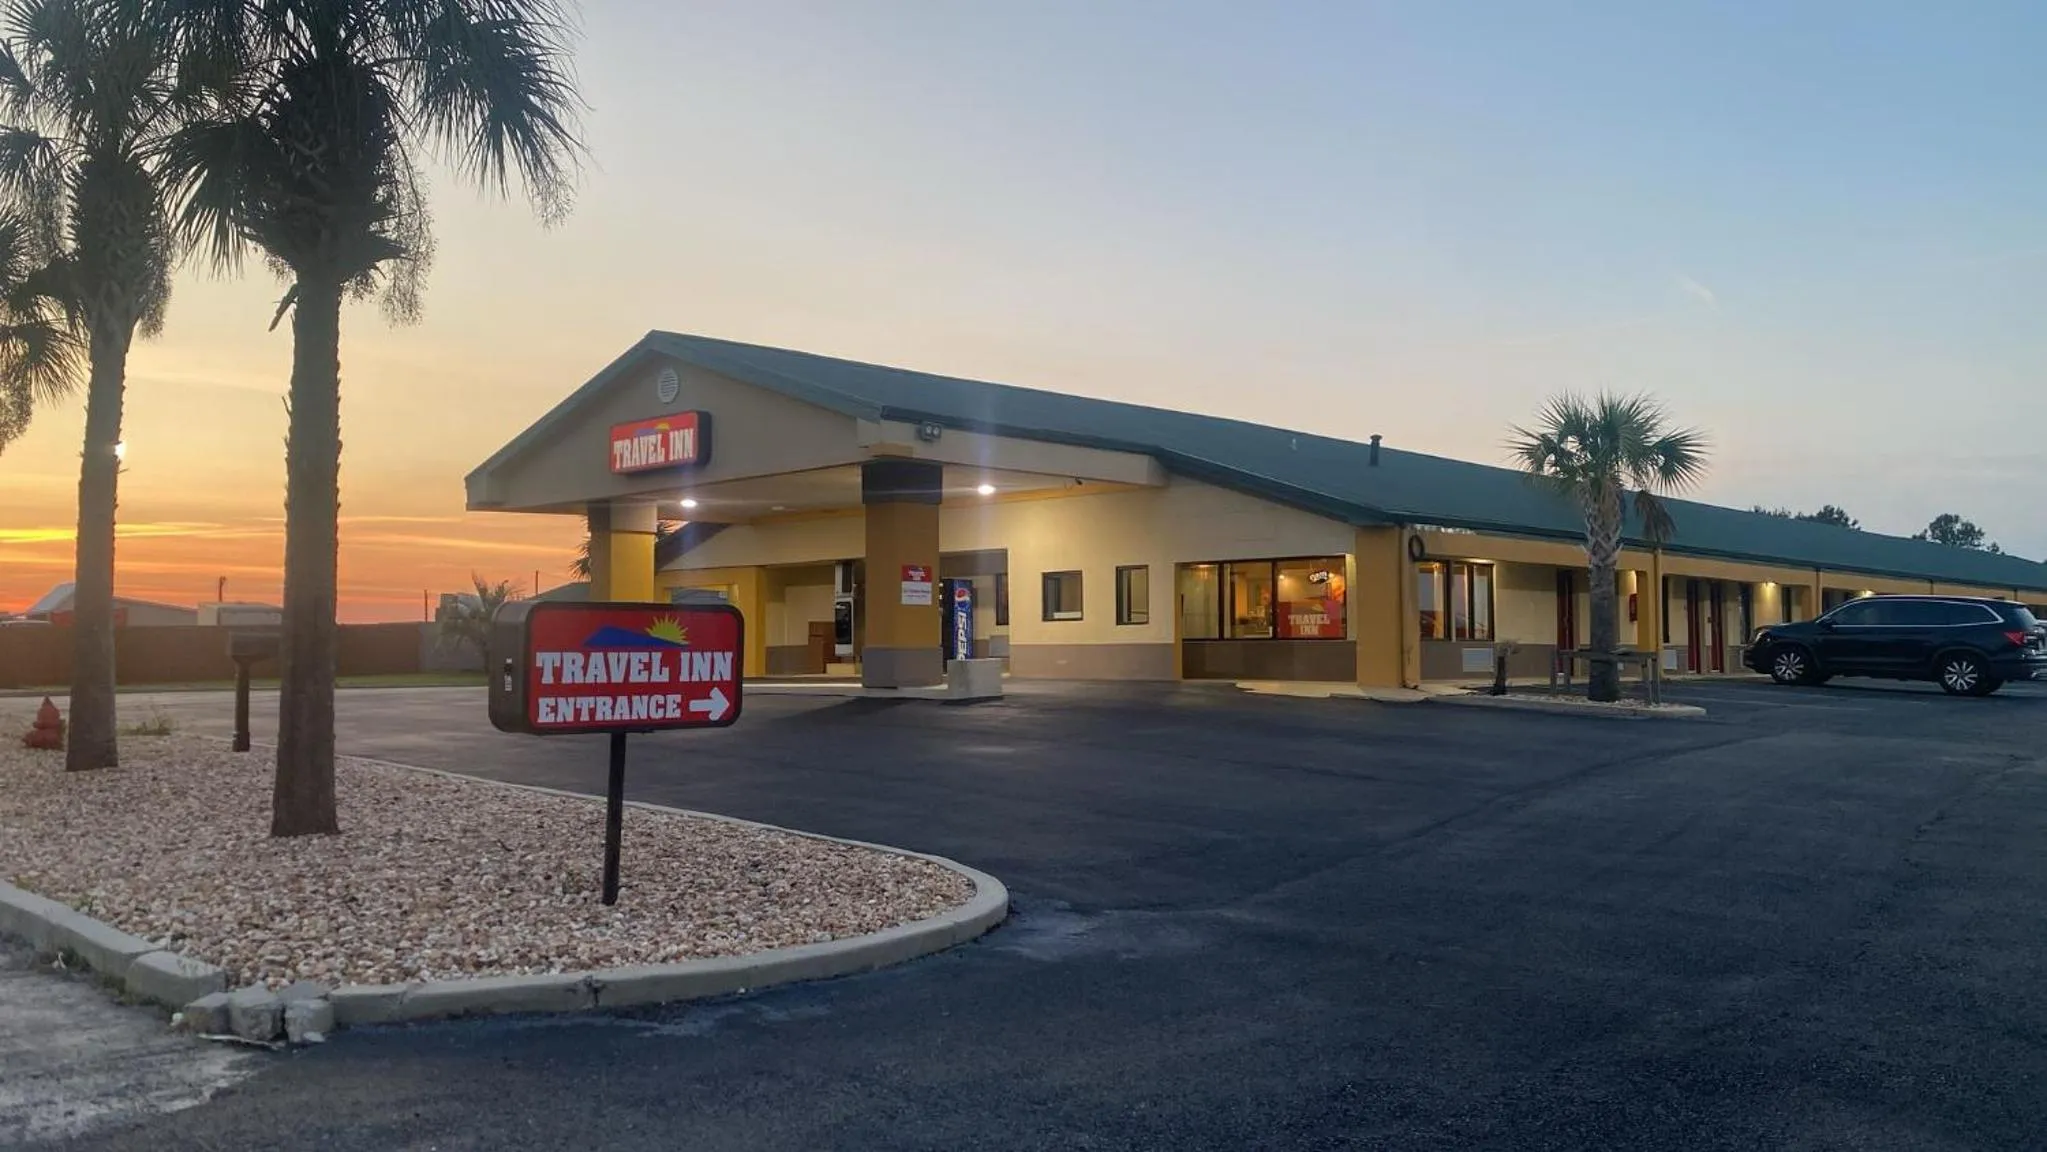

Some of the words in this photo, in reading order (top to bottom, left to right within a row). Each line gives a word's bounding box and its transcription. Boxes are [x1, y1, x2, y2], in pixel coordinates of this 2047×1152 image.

[613, 433, 665, 470] TRAVEL
[668, 428, 694, 461] INN
[1288, 613, 1330, 624] TRAVEL
[536, 652, 669, 684] TRAVEL
[679, 652, 733, 682] INN
[537, 695, 682, 722] ENTRANCE
